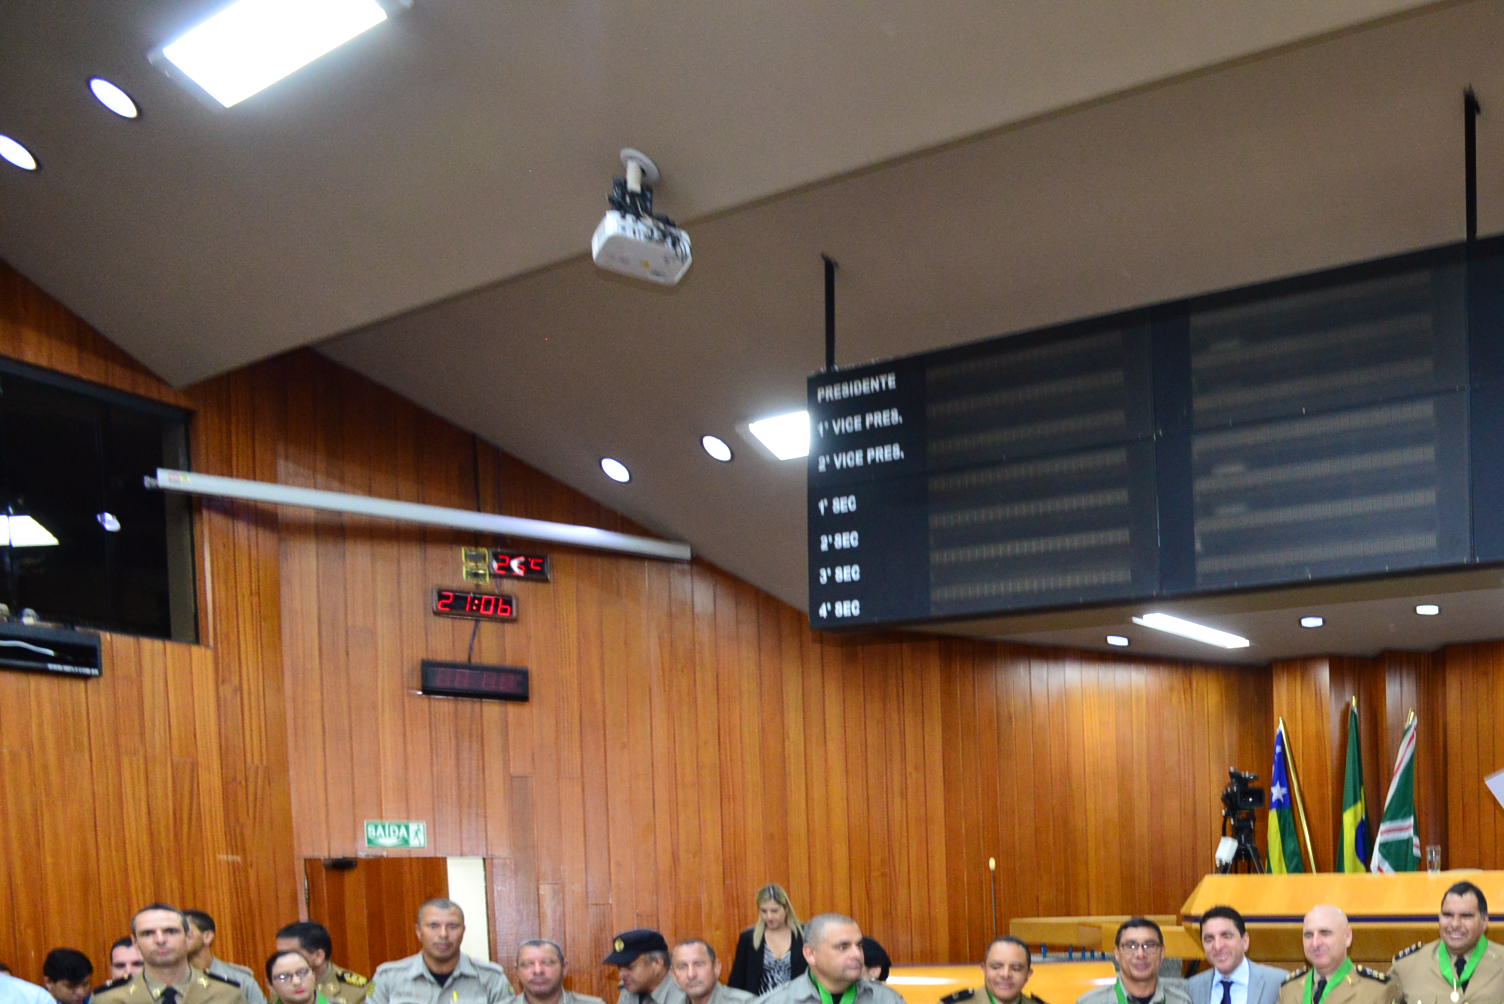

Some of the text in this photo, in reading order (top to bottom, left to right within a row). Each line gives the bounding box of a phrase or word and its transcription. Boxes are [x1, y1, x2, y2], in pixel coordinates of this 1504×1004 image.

[817, 373, 897, 404] PRESIDENTE
[832, 415, 862, 436] VICE
[833, 449, 864, 470] VICE
[832, 494, 857, 515] SEC
[834, 530, 859, 550] SEC
[834, 563, 860, 583] SEC
[437, 591, 512, 617] 21:06
[834, 599, 860, 618] SEC
